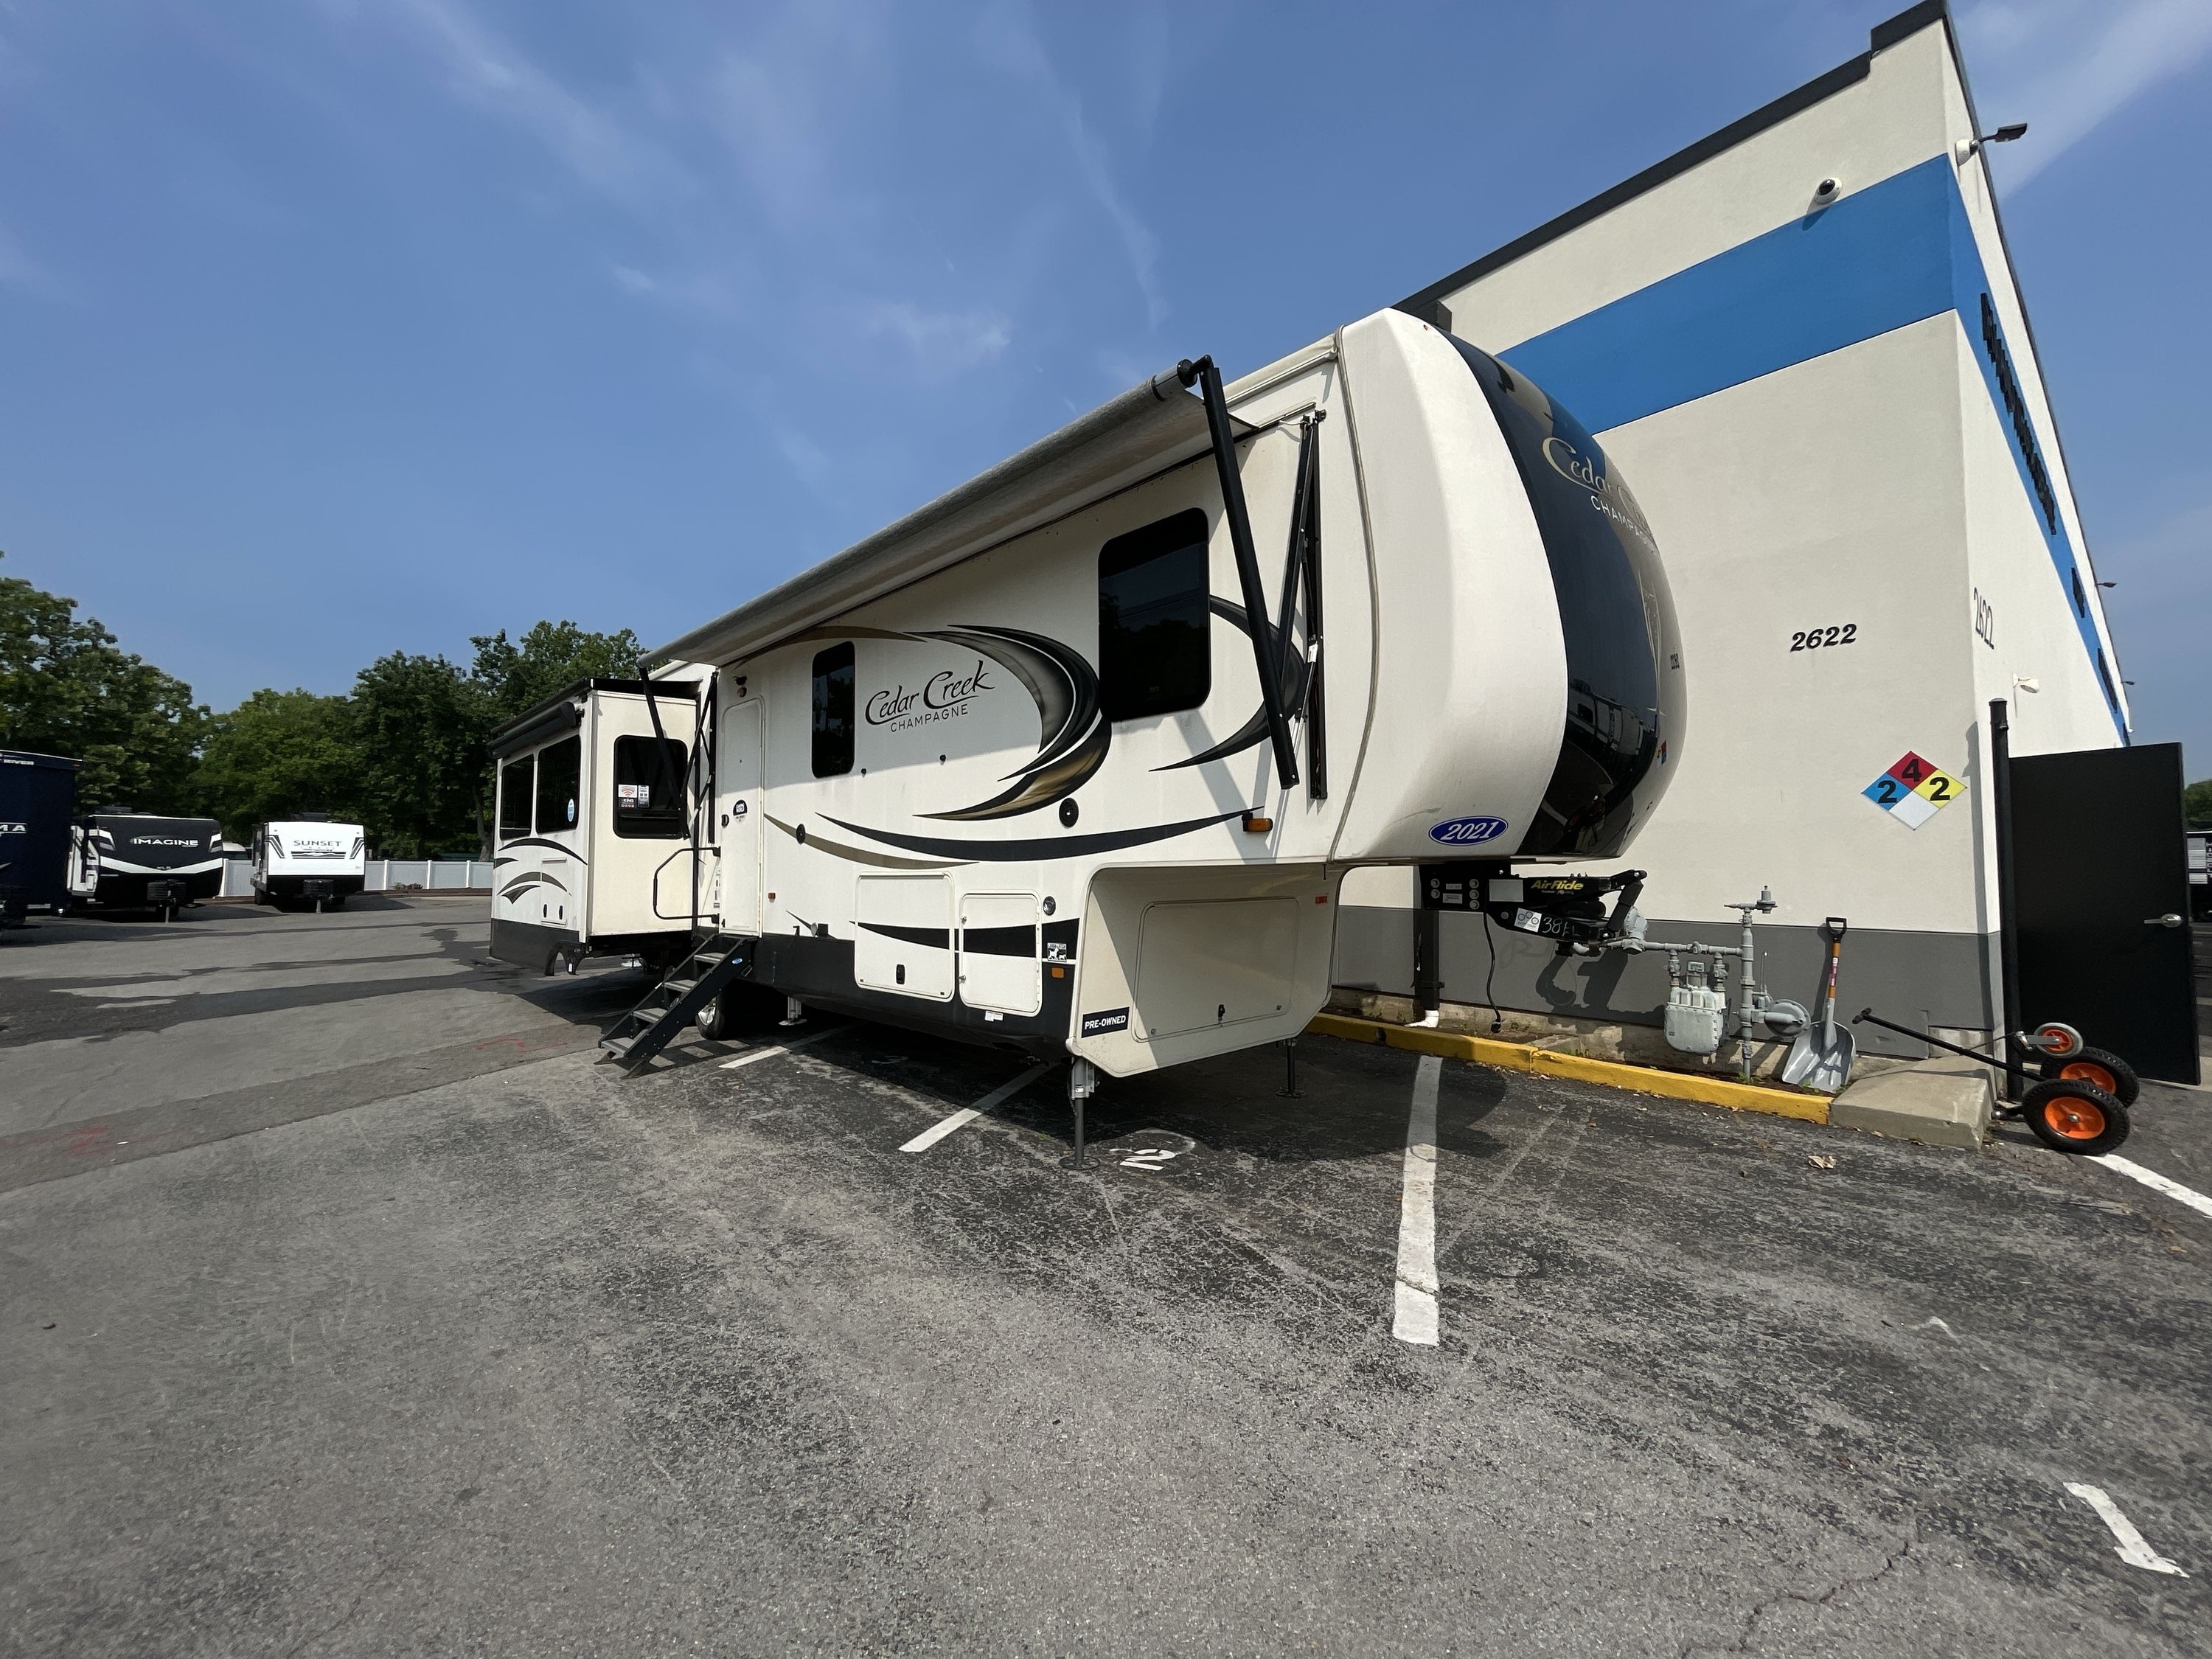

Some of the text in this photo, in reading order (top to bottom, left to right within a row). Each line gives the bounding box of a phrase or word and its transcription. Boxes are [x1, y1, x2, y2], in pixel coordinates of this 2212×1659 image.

[1542, 437, 1613, 502] Cedar
[1973, 587, 1994, 650] 2622
[1790, 623, 1857, 653] 2622
[865, 659, 996, 726] Cedar Creek
[890, 703, 968, 732] CHAMPAGNE
[1902, 758, 1921, 782] 4
[1877, 780, 1897, 804] 2
[1929, 776, 1951, 801] 2
[1440, 821, 1499, 841] 2021
[1085, 1015, 1127, 1030] PRE-OWNED
